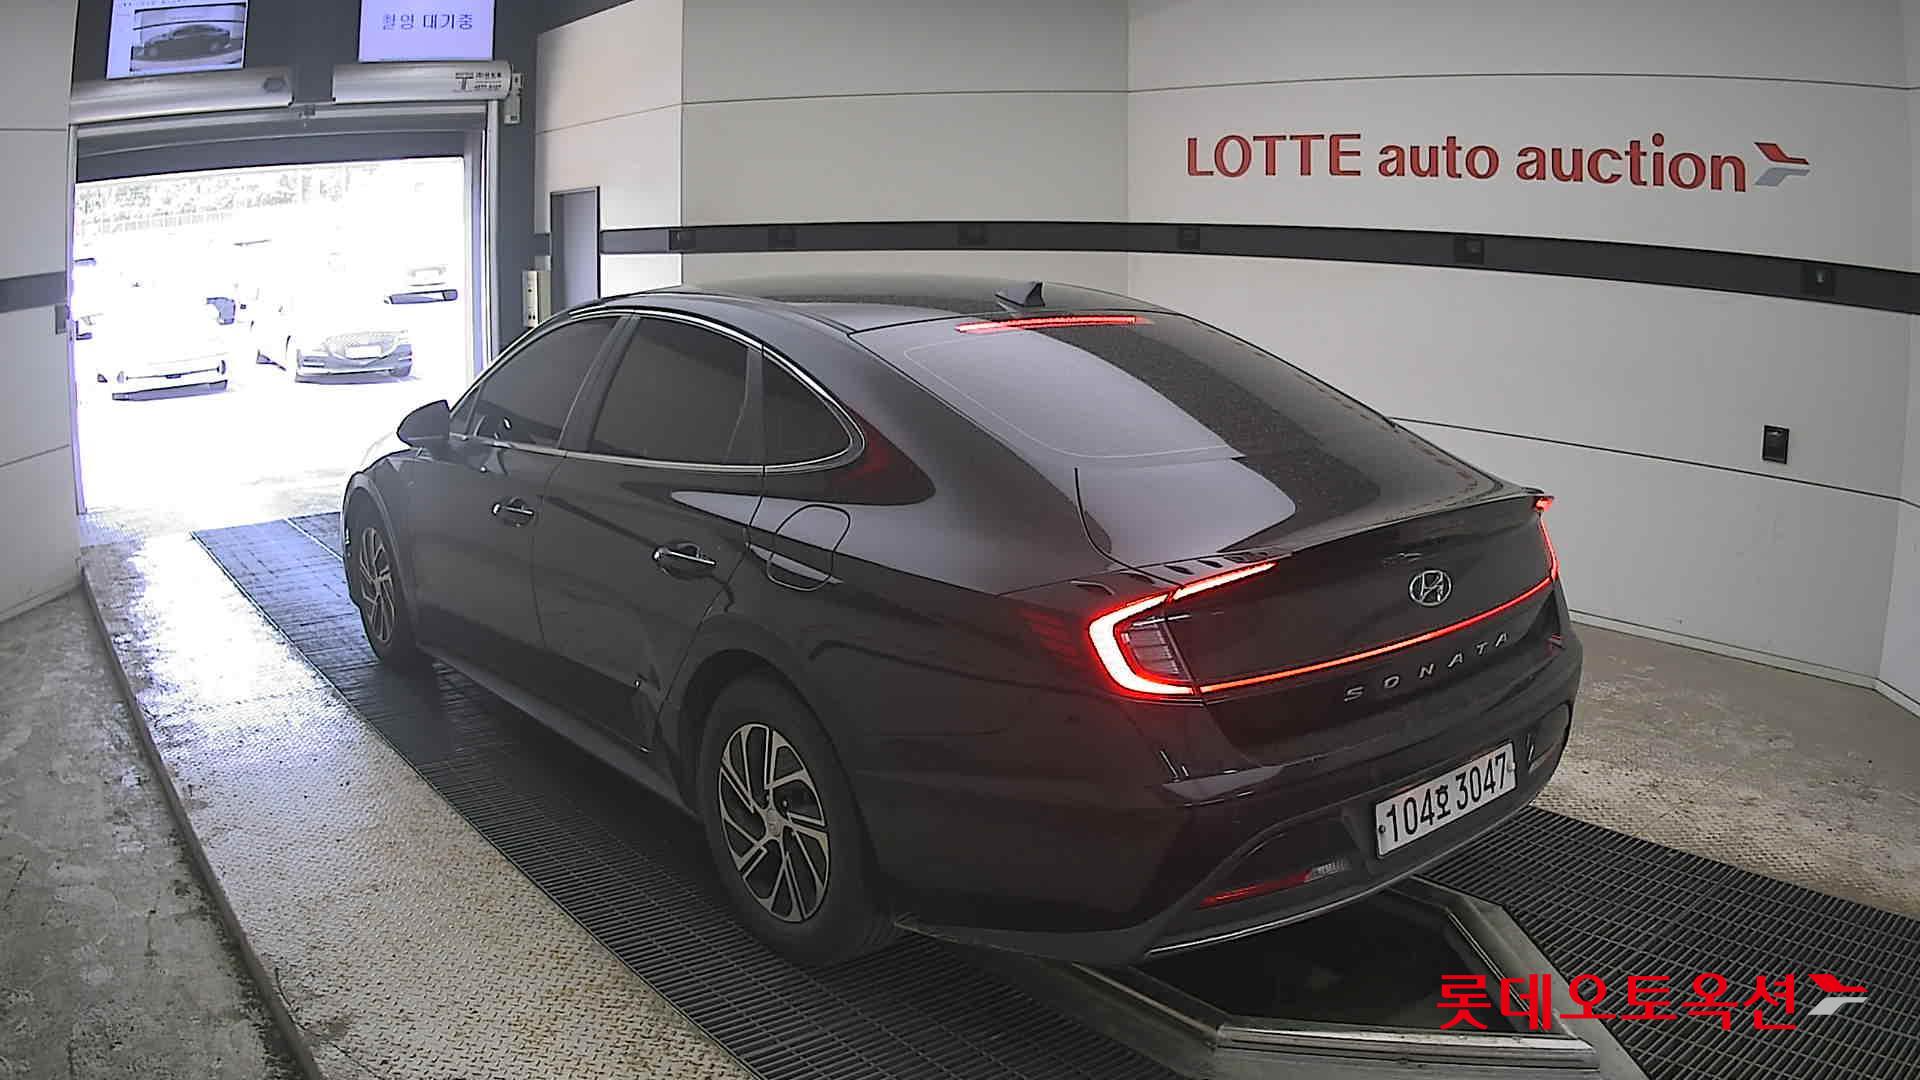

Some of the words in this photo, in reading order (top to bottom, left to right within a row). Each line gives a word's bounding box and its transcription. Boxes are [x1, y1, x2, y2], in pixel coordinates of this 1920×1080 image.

[423, 13, 473, 30] 대기중
[1186, 133, 1362, 177] LOTTE
[1377, 136, 1500, 181] auto
[1515, 132, 1747, 193] auction
[1343, 631, 1512, 703] SONATA
[1455, 751, 1506, 810] 3047
